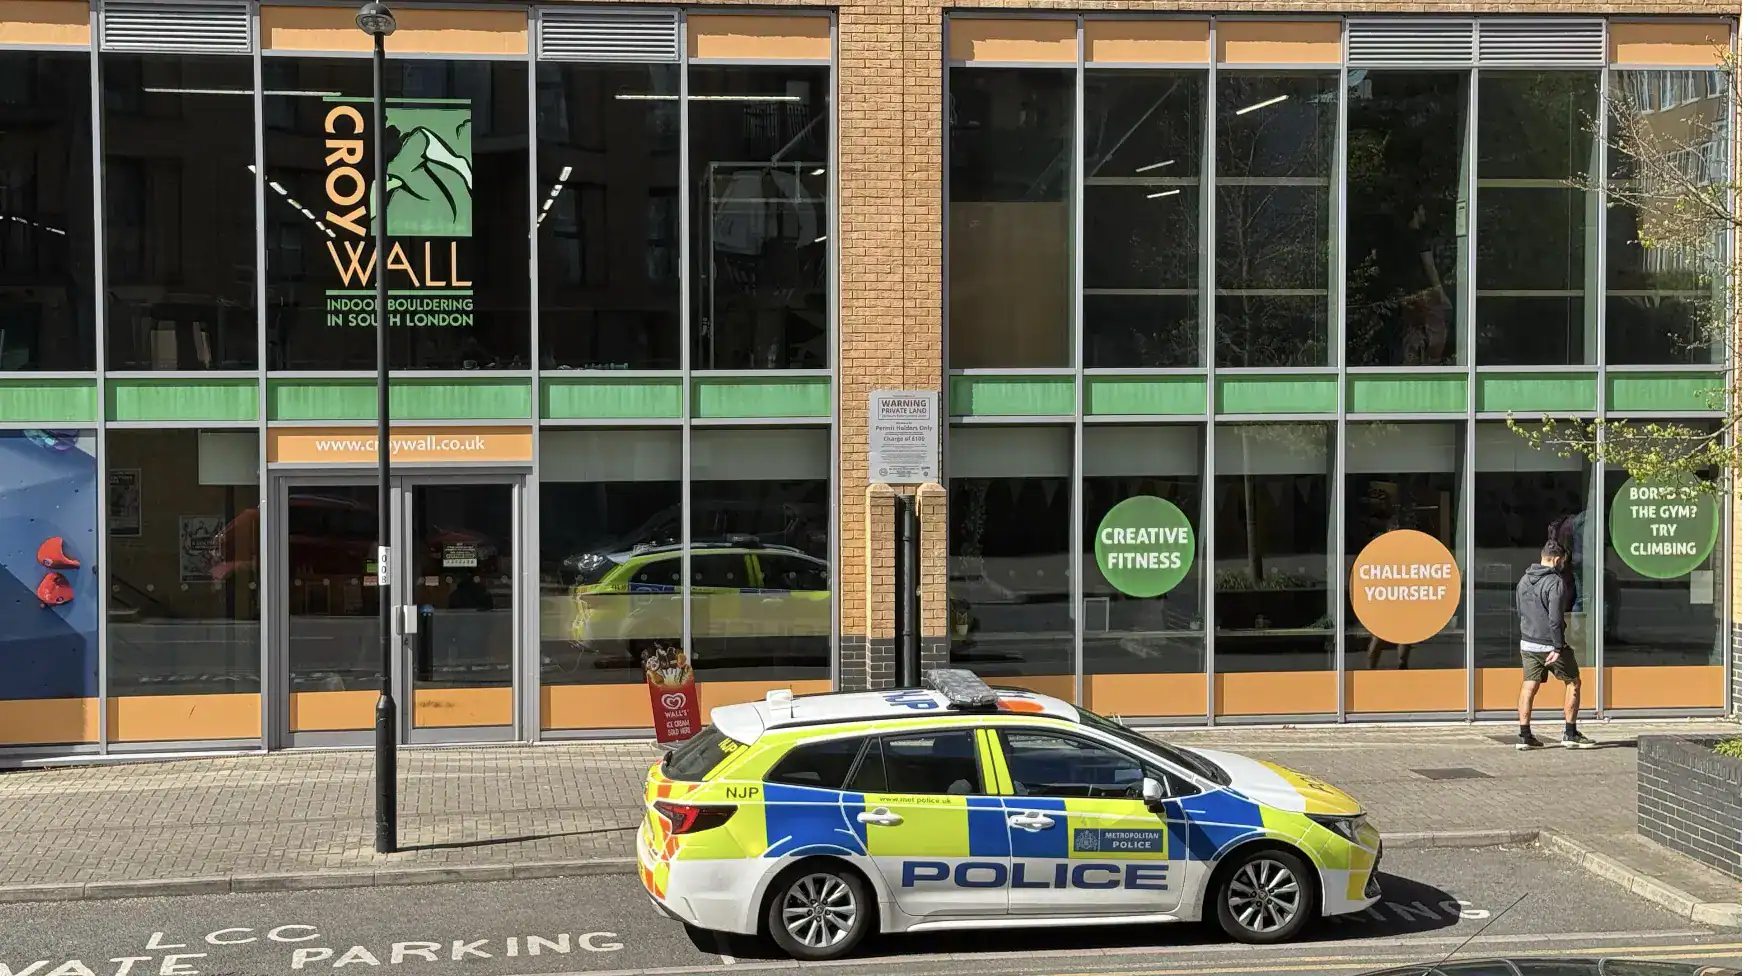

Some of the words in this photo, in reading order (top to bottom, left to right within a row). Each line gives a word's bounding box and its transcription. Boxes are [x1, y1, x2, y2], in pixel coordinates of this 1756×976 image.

[324, 105, 367, 238] CROY
[326, 241, 473, 287] WALL
[387, 299, 473, 310] BOULDERING
[327, 314, 343, 326] IN
[349, 314, 401, 326] SOUH
[407, 314, 474, 326] LONDON
[881, 399, 927, 407] WARNING
[315, 435, 486, 455] www.crywall.co.uk
[1630, 505, 1657, 518] THE
[1659, 504, 1698, 518] GYM?
[1101, 527, 1189, 545] CREATIVE
[1650, 523, 1678, 537] TRY
[1630, 541, 1697, 556] CLIMBING
[1108, 552, 1182, 569] FITNESS
[1359, 563, 1452, 580] CHALLENGE
[1364, 585, 1447, 601] YOURSELF
[664, 709, 688, 718] WALL'S
[726, 786, 759, 799] NJP
[1105, 831, 1159, 839] METROPOLITAN
[1112, 841, 1152, 849] POLICE
[901, 860, 1169, 890] POLICE
[145, 924, 321, 950] LCC
[291, 931, 624, 969] PARKING
